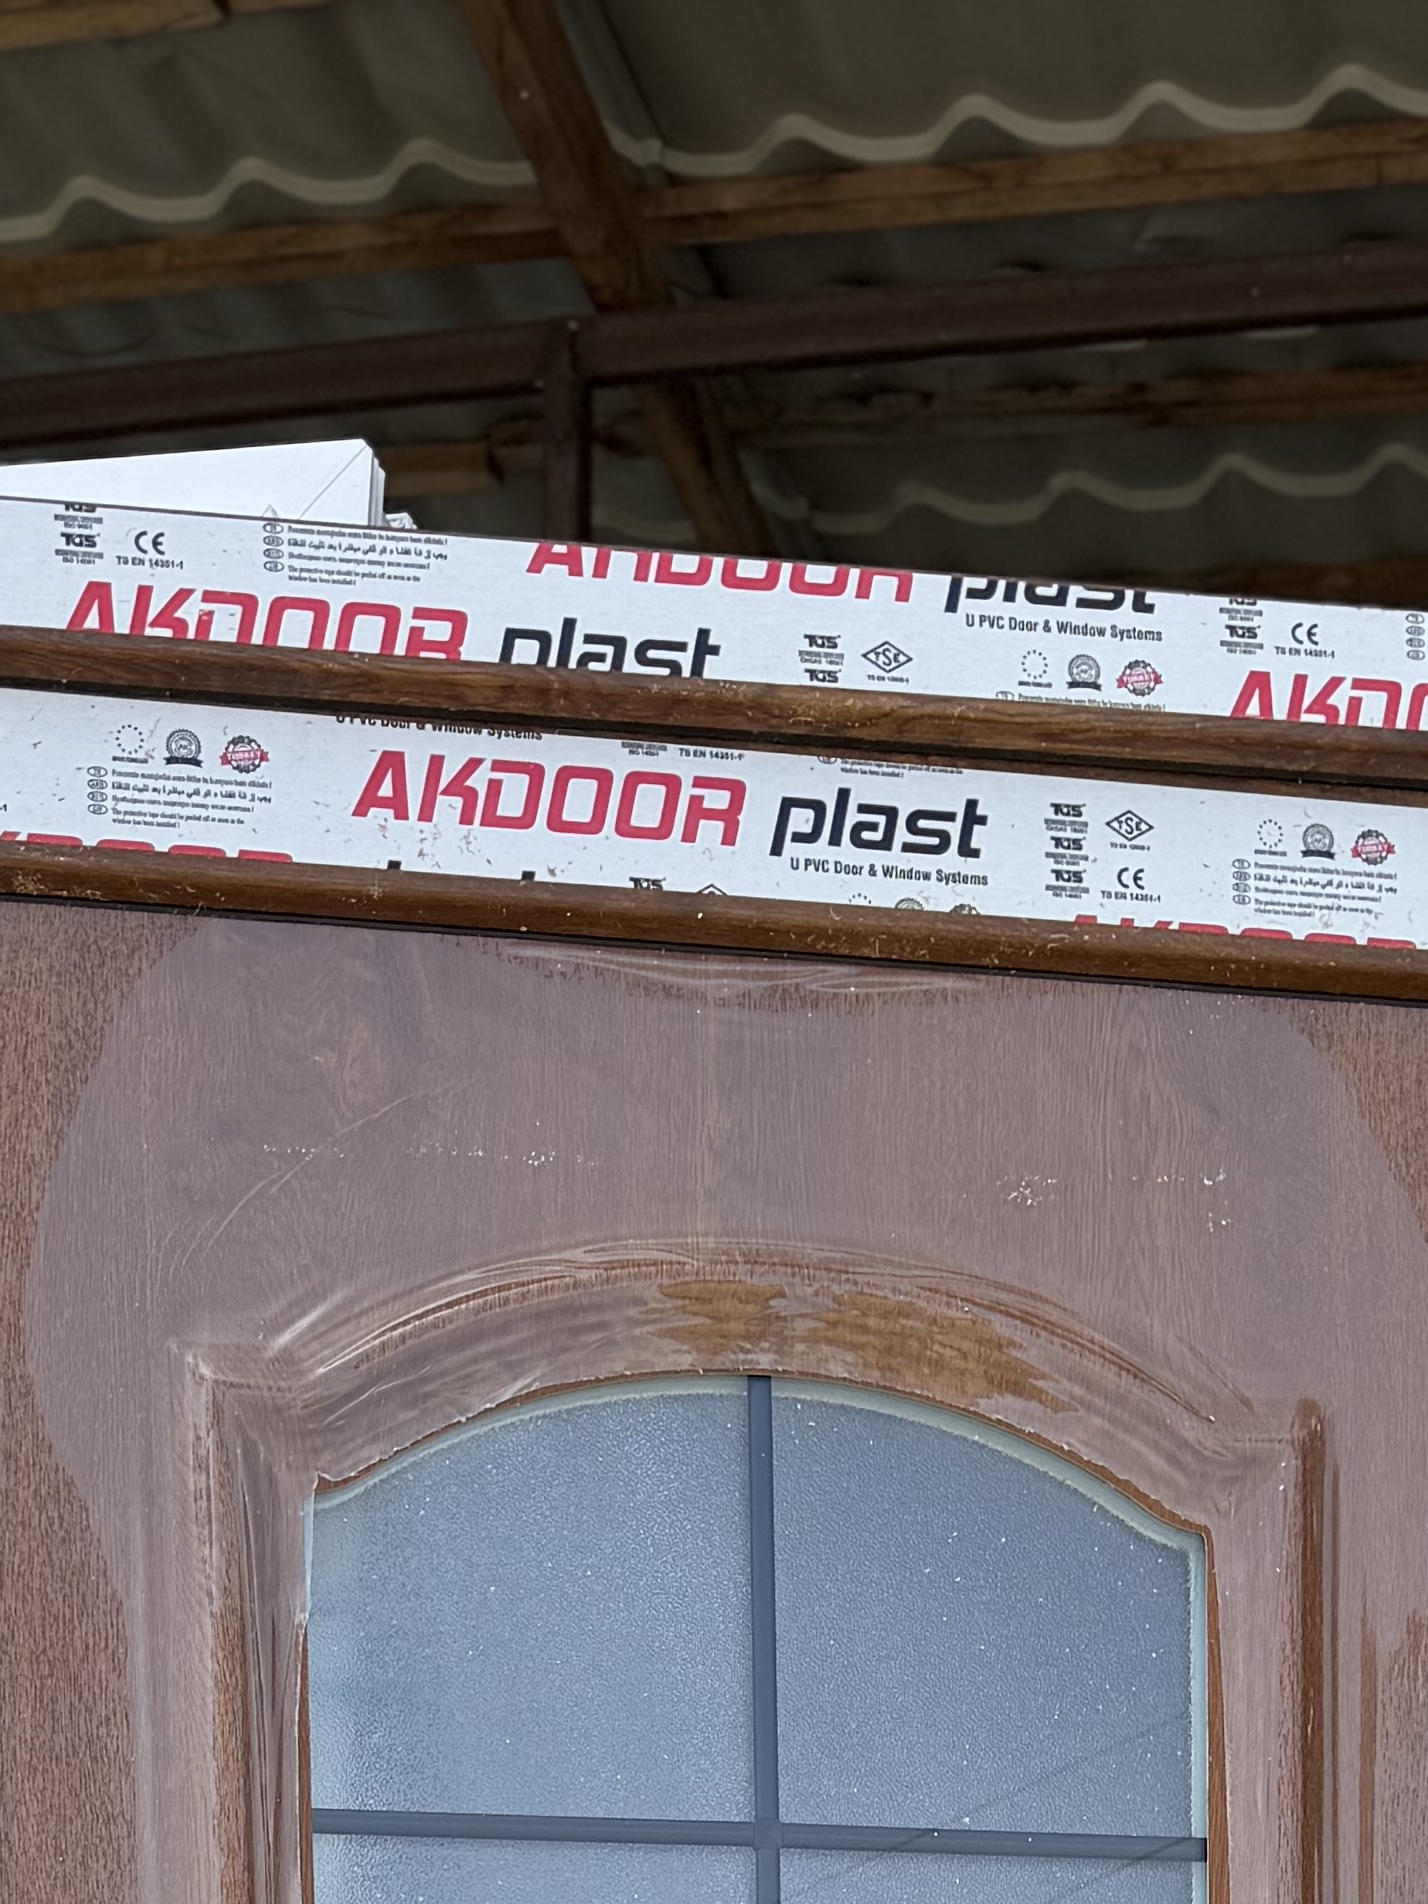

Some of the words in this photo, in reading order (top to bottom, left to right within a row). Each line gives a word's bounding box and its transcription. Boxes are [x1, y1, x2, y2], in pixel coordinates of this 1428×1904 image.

[132, 531, 165, 559] CE
[352, 750, 746, 847] AKDOOR
[768, 787, 989, 859] plast
[790, 856, 800, 871] U
[803, 858, 830, 874] PVC
[833, 860, 864, 876] Door
[867, 863, 878, 877] &
[881, 864, 932, 882] Window
[935, 868, 989, 886] Systems
